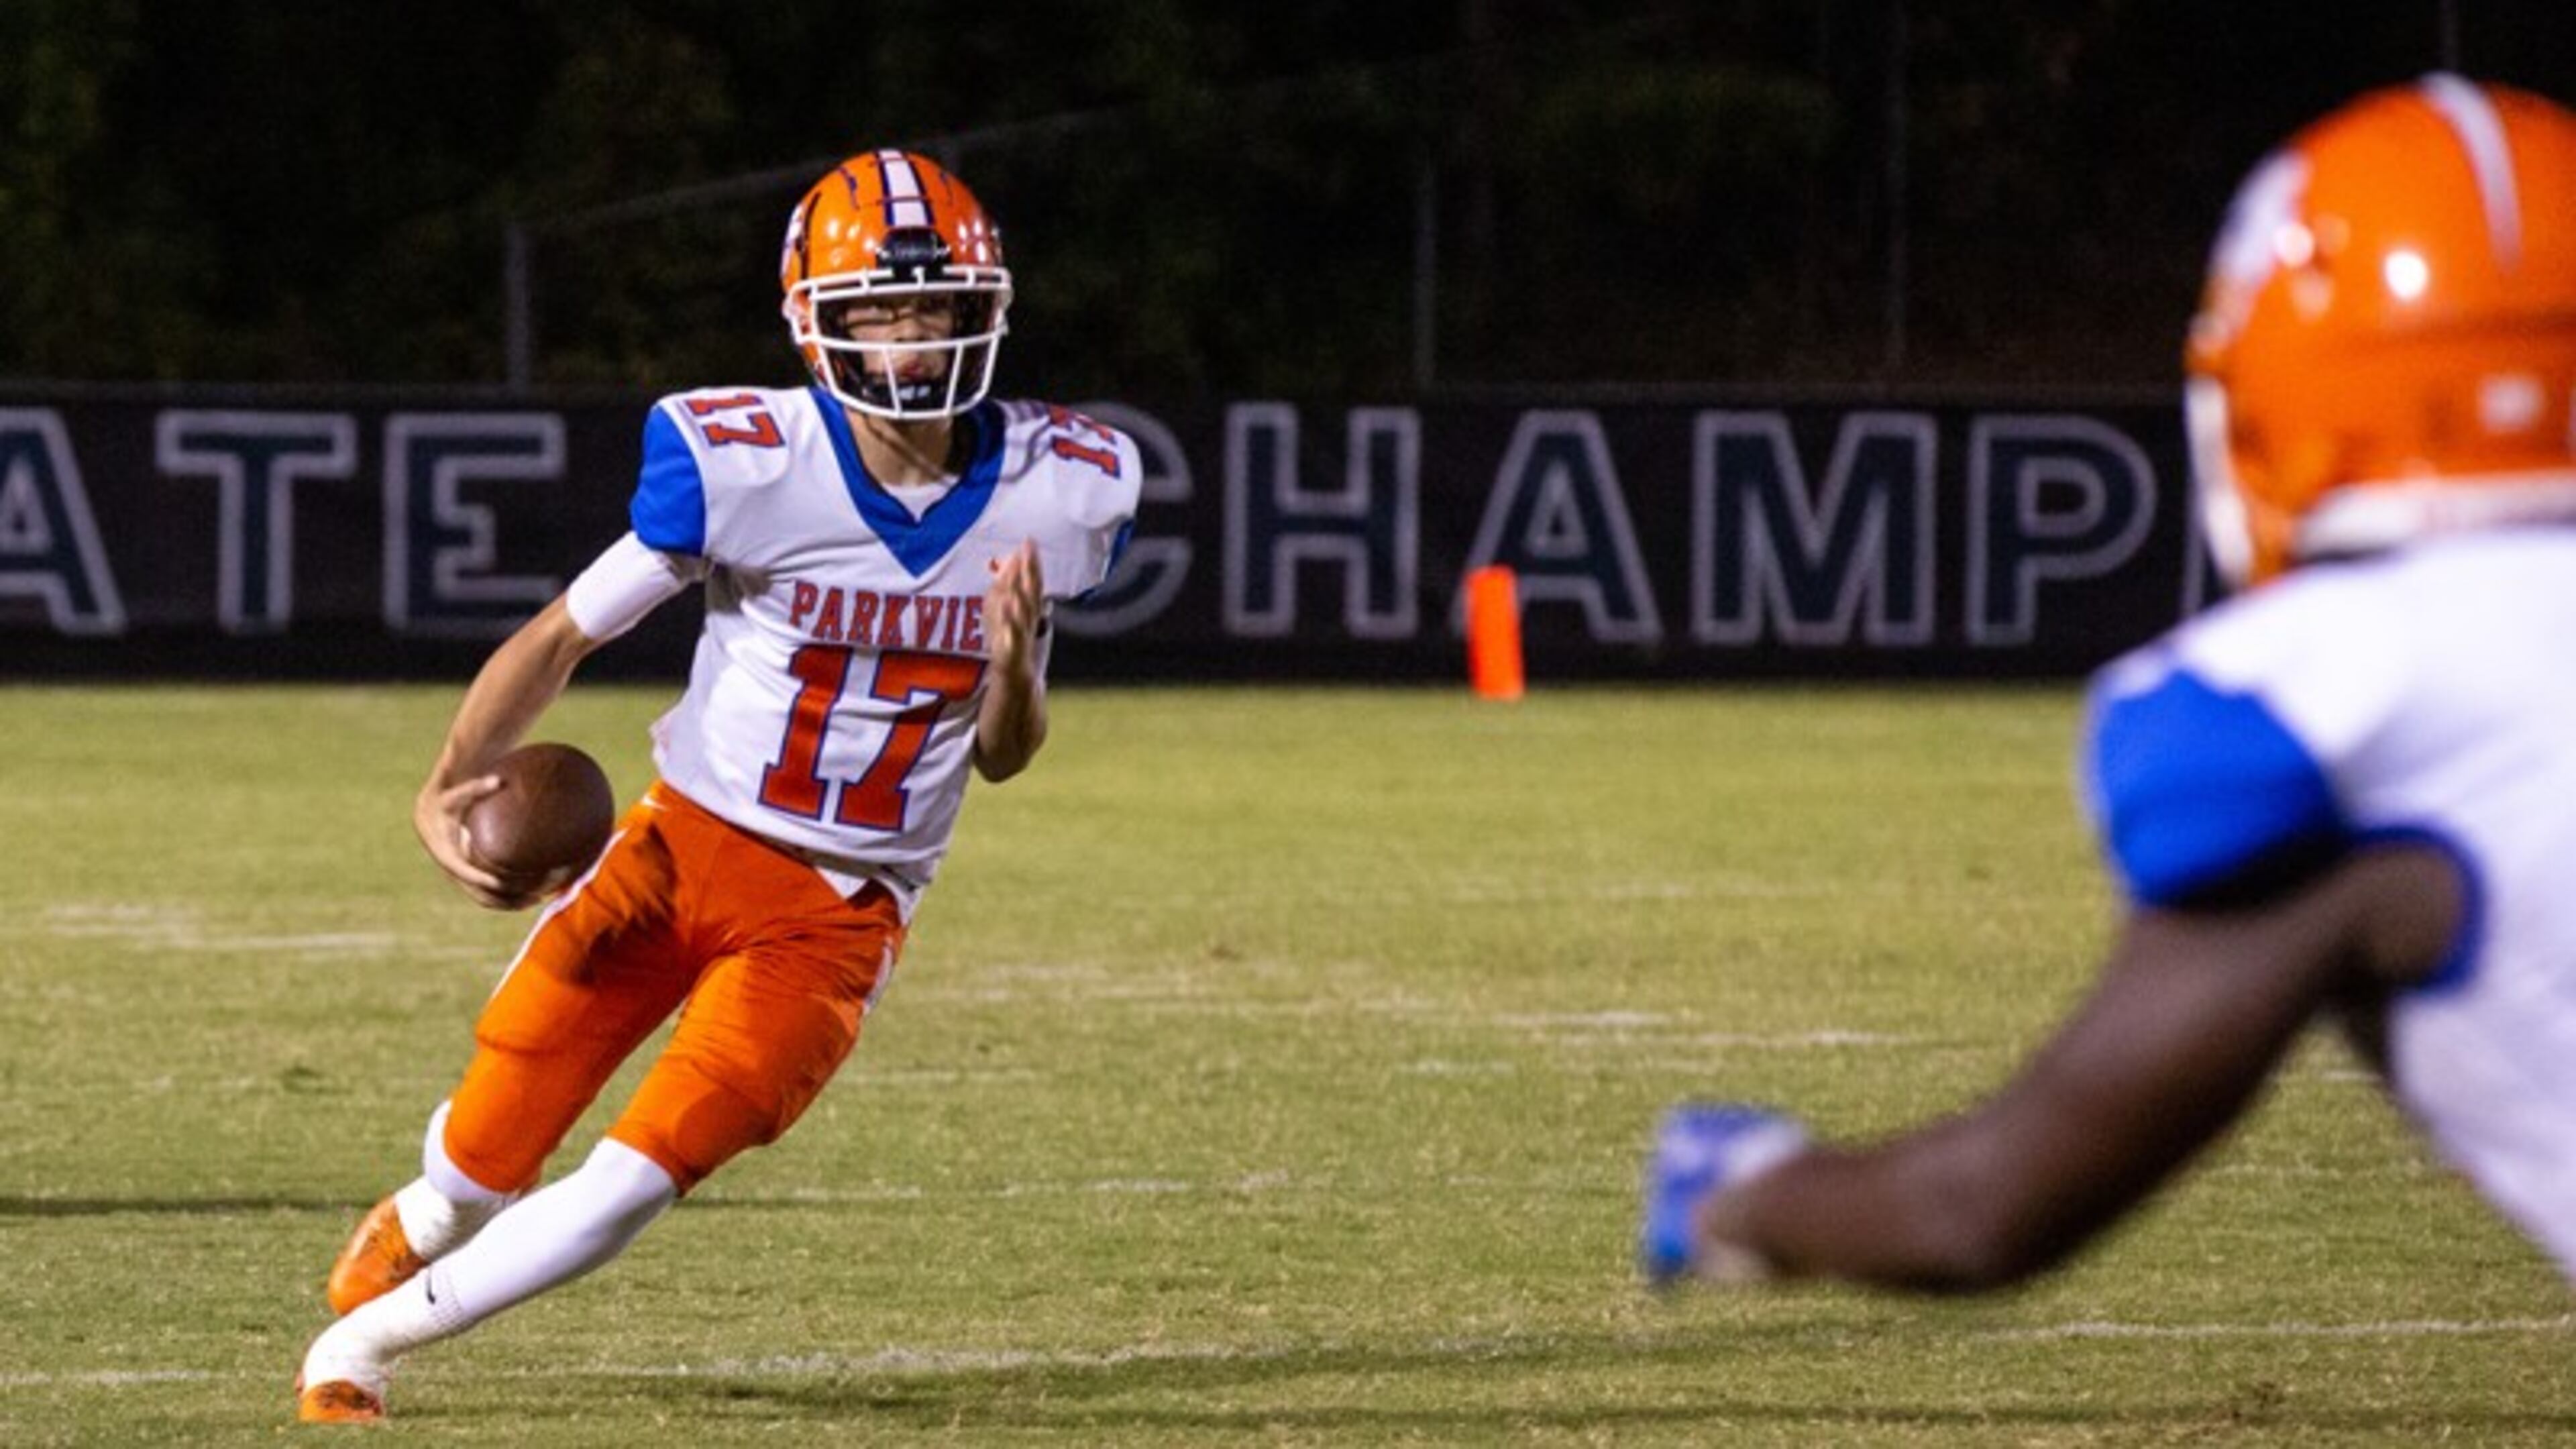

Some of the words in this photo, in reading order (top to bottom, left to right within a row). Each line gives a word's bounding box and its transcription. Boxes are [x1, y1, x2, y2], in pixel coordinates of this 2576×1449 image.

[684, 392, 786, 448] 17
[1048, 401, 2207, 647] CHAMP
[790, 578, 985, 651] PARKVIE
[757, 643, 990, 832] 17
